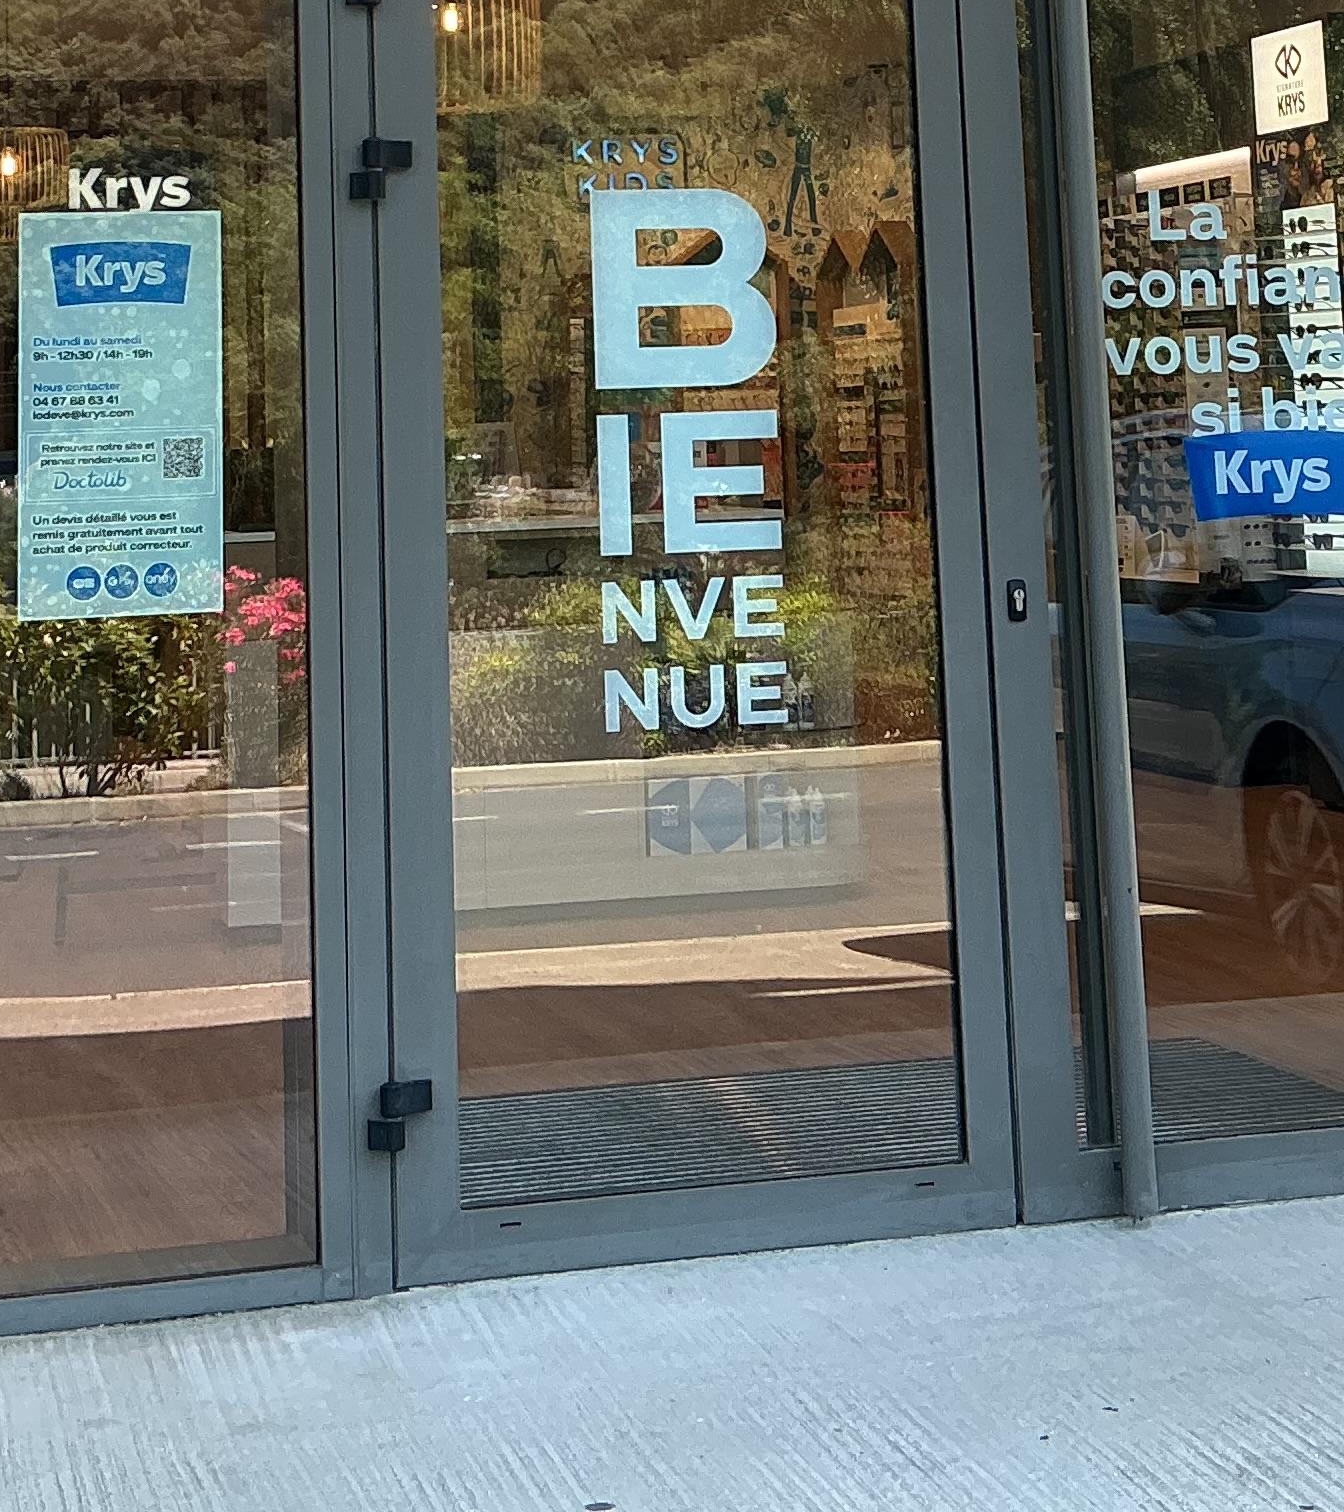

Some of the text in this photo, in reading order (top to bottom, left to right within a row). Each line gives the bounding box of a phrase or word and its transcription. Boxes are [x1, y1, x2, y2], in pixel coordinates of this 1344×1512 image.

[1277, 91, 1305, 117] KRYS
[571, 137, 678, 165] KRYS
[68, 168, 191, 212] Krys
[1147, 189, 1227, 241] La
[75, 254, 166, 293] Krys
[589, 188, 777, 390] B
[33, 337, 50, 347] Du
[52, 337, 81, 346] lundi
[100, 336, 142, 345] samedi
[33, 352, 48, 361] 9h
[57, 350, 94, 360] 12h30
[103, 350, 124, 359] 14h
[132, 349, 153, 358] 19h
[1105, 330, 1259, 375] vous
[33, 383, 63, 392] Nous
[33, 395, 119, 406] 04 67 88 63 41
[1191, 388, 1243, 438] si
[40, 454, 156, 467] prenez rendez-vous ICI
[41, 443, 93, 453] Retrouvez
[95, 443, 122, 451] notre
[125, 442, 143, 450] site
[53, 470, 127, 489] Doctolib
[594, 408, 783, 557] IE
[1213, 448, 1331, 503] Krys
[33, 512, 177, 525] Un devis détaillé vous est
[33, 525, 204, 541] remis gratuitement avant tout
[33, 540, 192, 555] achat de produit correcteur.
[601, 574, 785, 645] NVE
[603, 661, 789, 734] NUE
